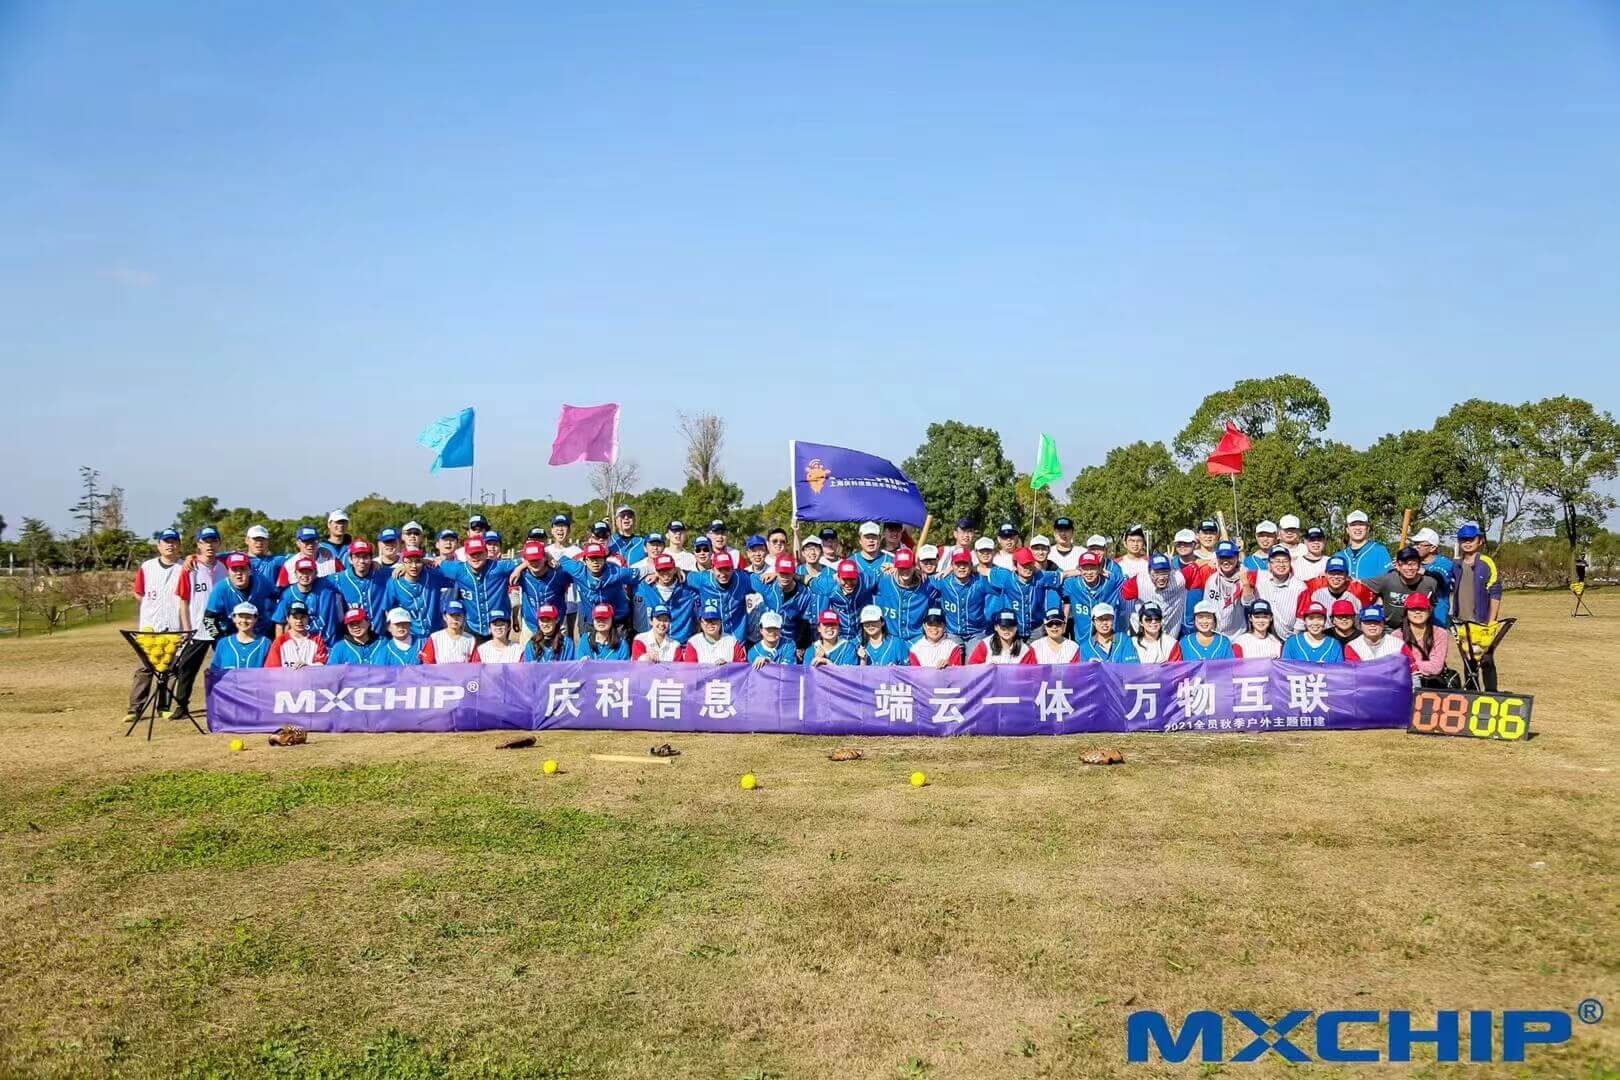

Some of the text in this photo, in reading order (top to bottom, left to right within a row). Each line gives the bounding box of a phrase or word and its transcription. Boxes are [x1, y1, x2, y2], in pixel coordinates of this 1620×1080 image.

[544, 677, 737, 719] 庆科信息
[1412, 692, 1525, 740] 08 06
